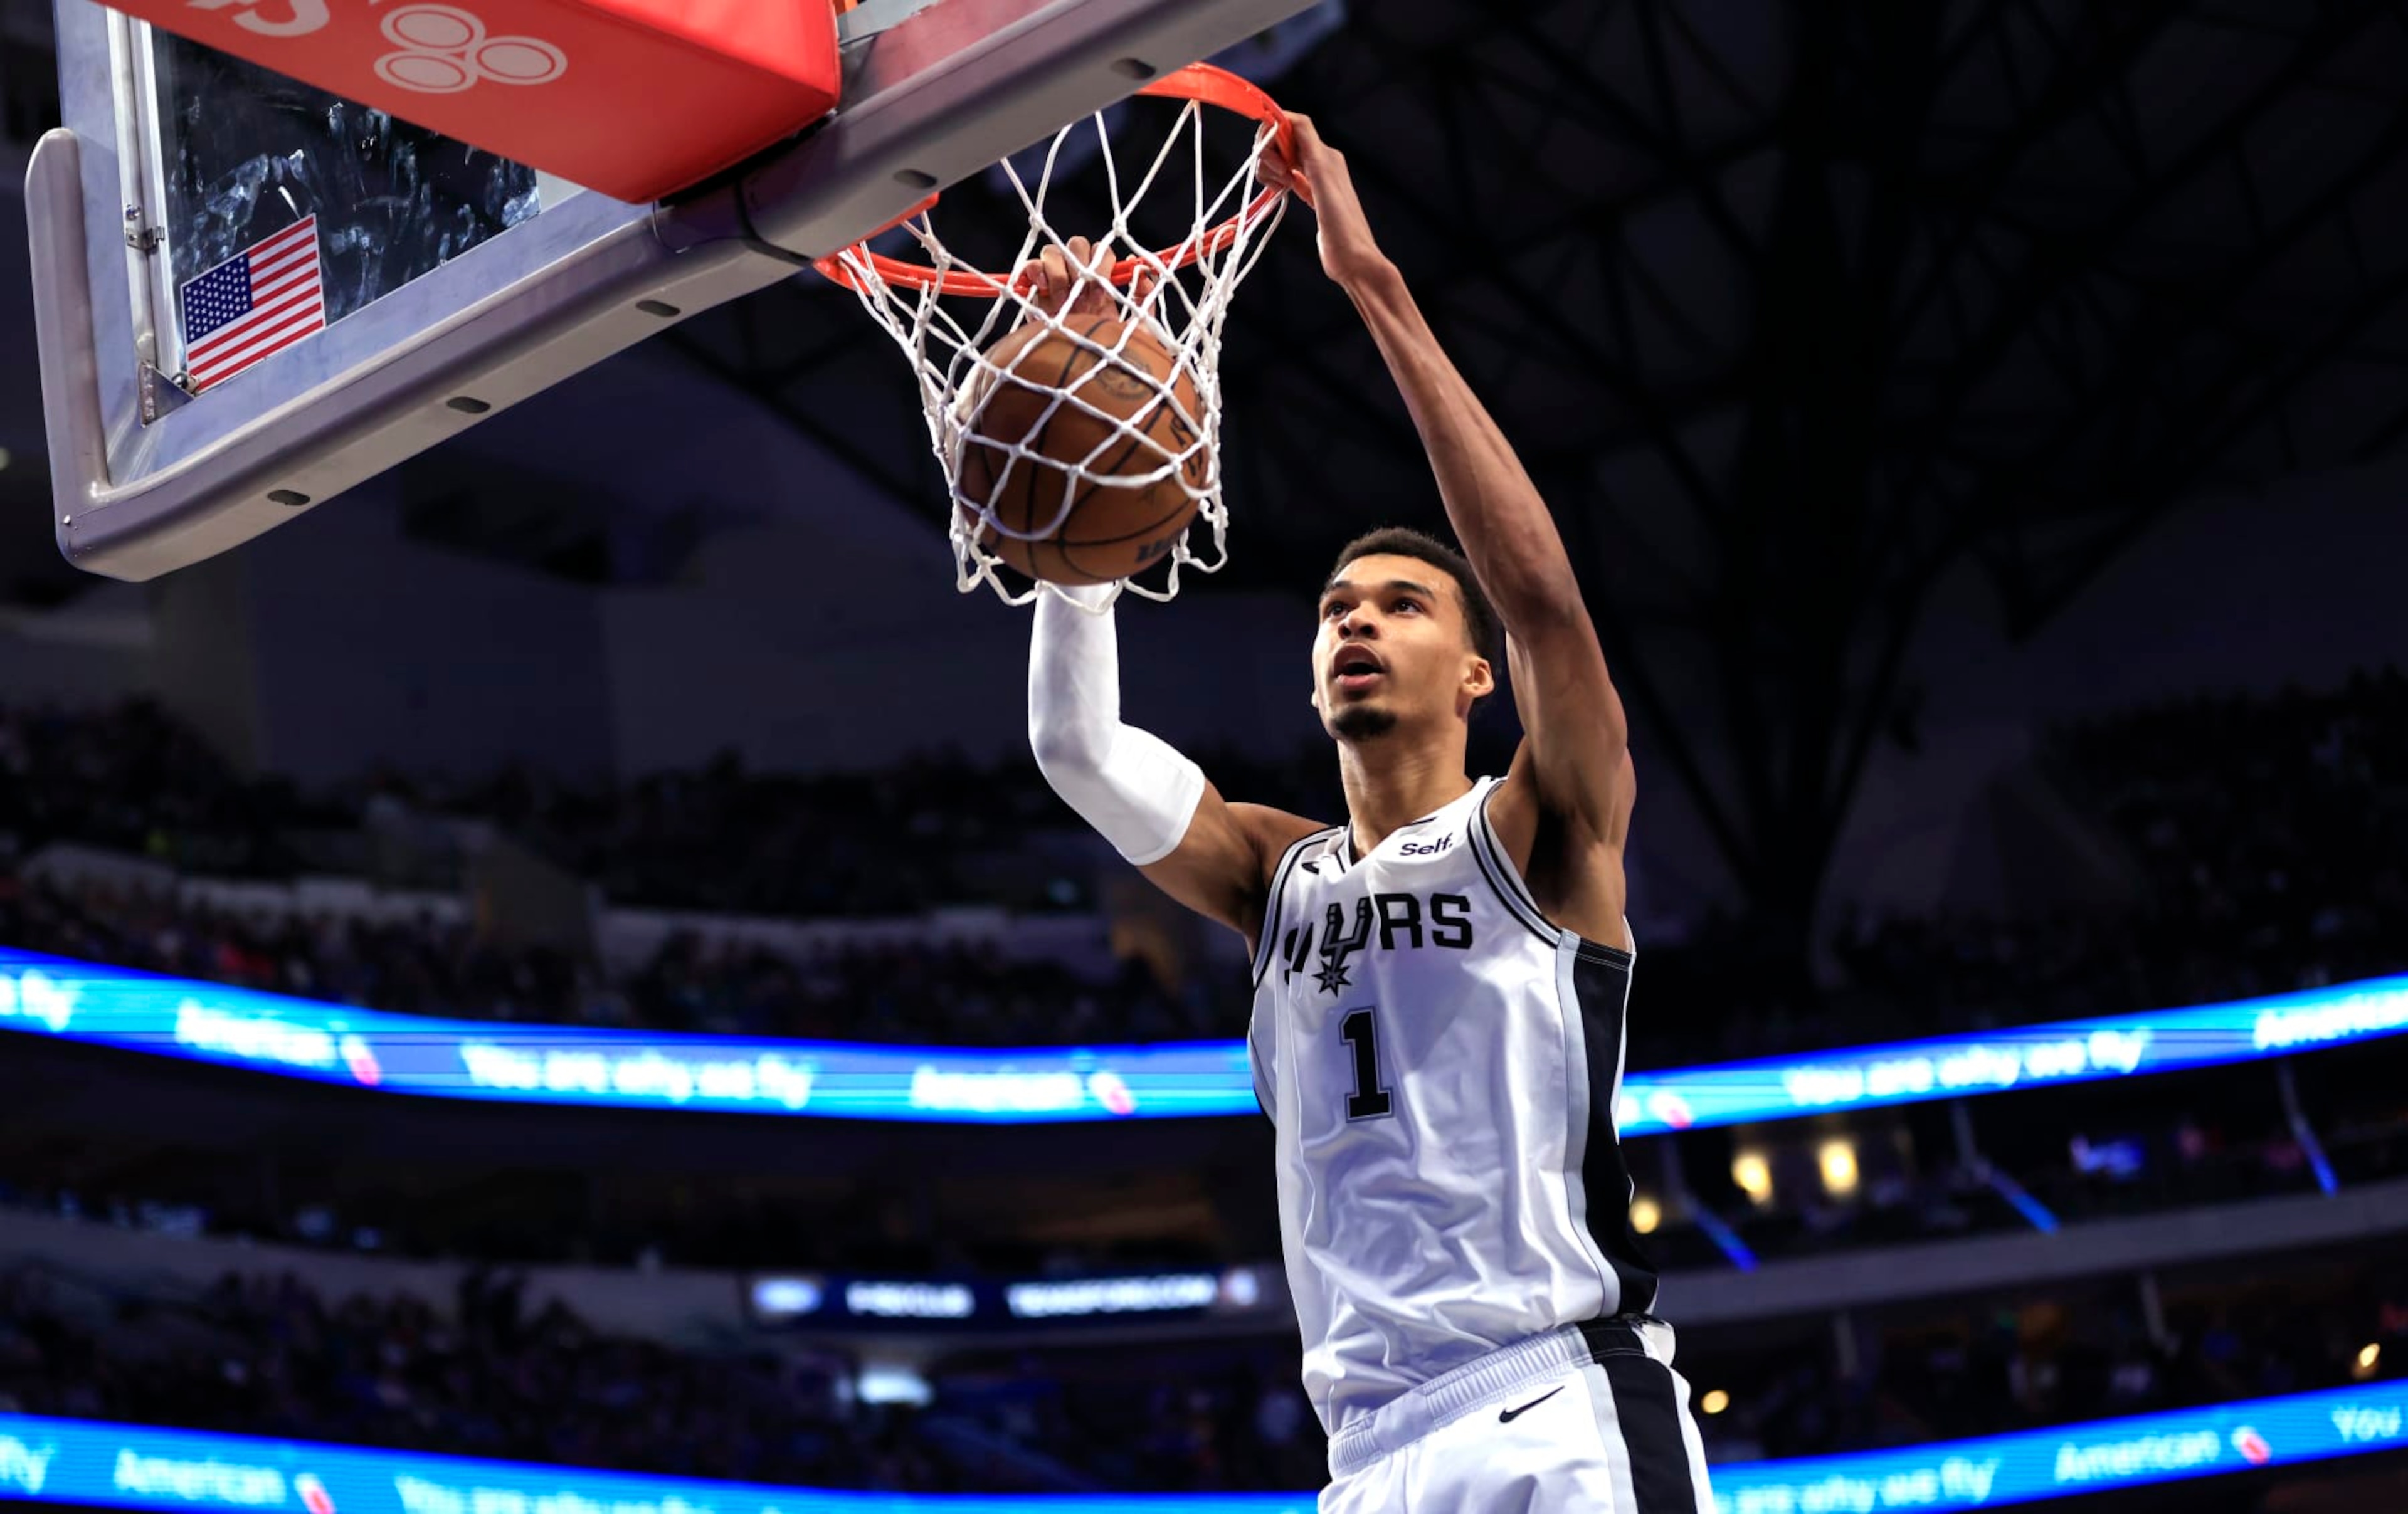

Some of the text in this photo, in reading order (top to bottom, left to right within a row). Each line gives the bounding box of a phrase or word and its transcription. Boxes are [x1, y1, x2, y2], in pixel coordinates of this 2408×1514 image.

[460, 1038, 540, 1088] You
[754, 1053, 818, 1110] fly
[1338, 1006, 1393, 1123] 1
[1783, 1065, 1864, 1105] You
[2088, 1026, 2154, 1073] fly
[2331, 1402, 2402, 1444] You
[113, 1448, 287, 1505] American
[1798, 1475, 1877, 1514] why
[1879, 1468, 1940, 1507] we
[1940, 1449, 2003, 1504] fly
[2054, 1429, 2221, 1485] American
